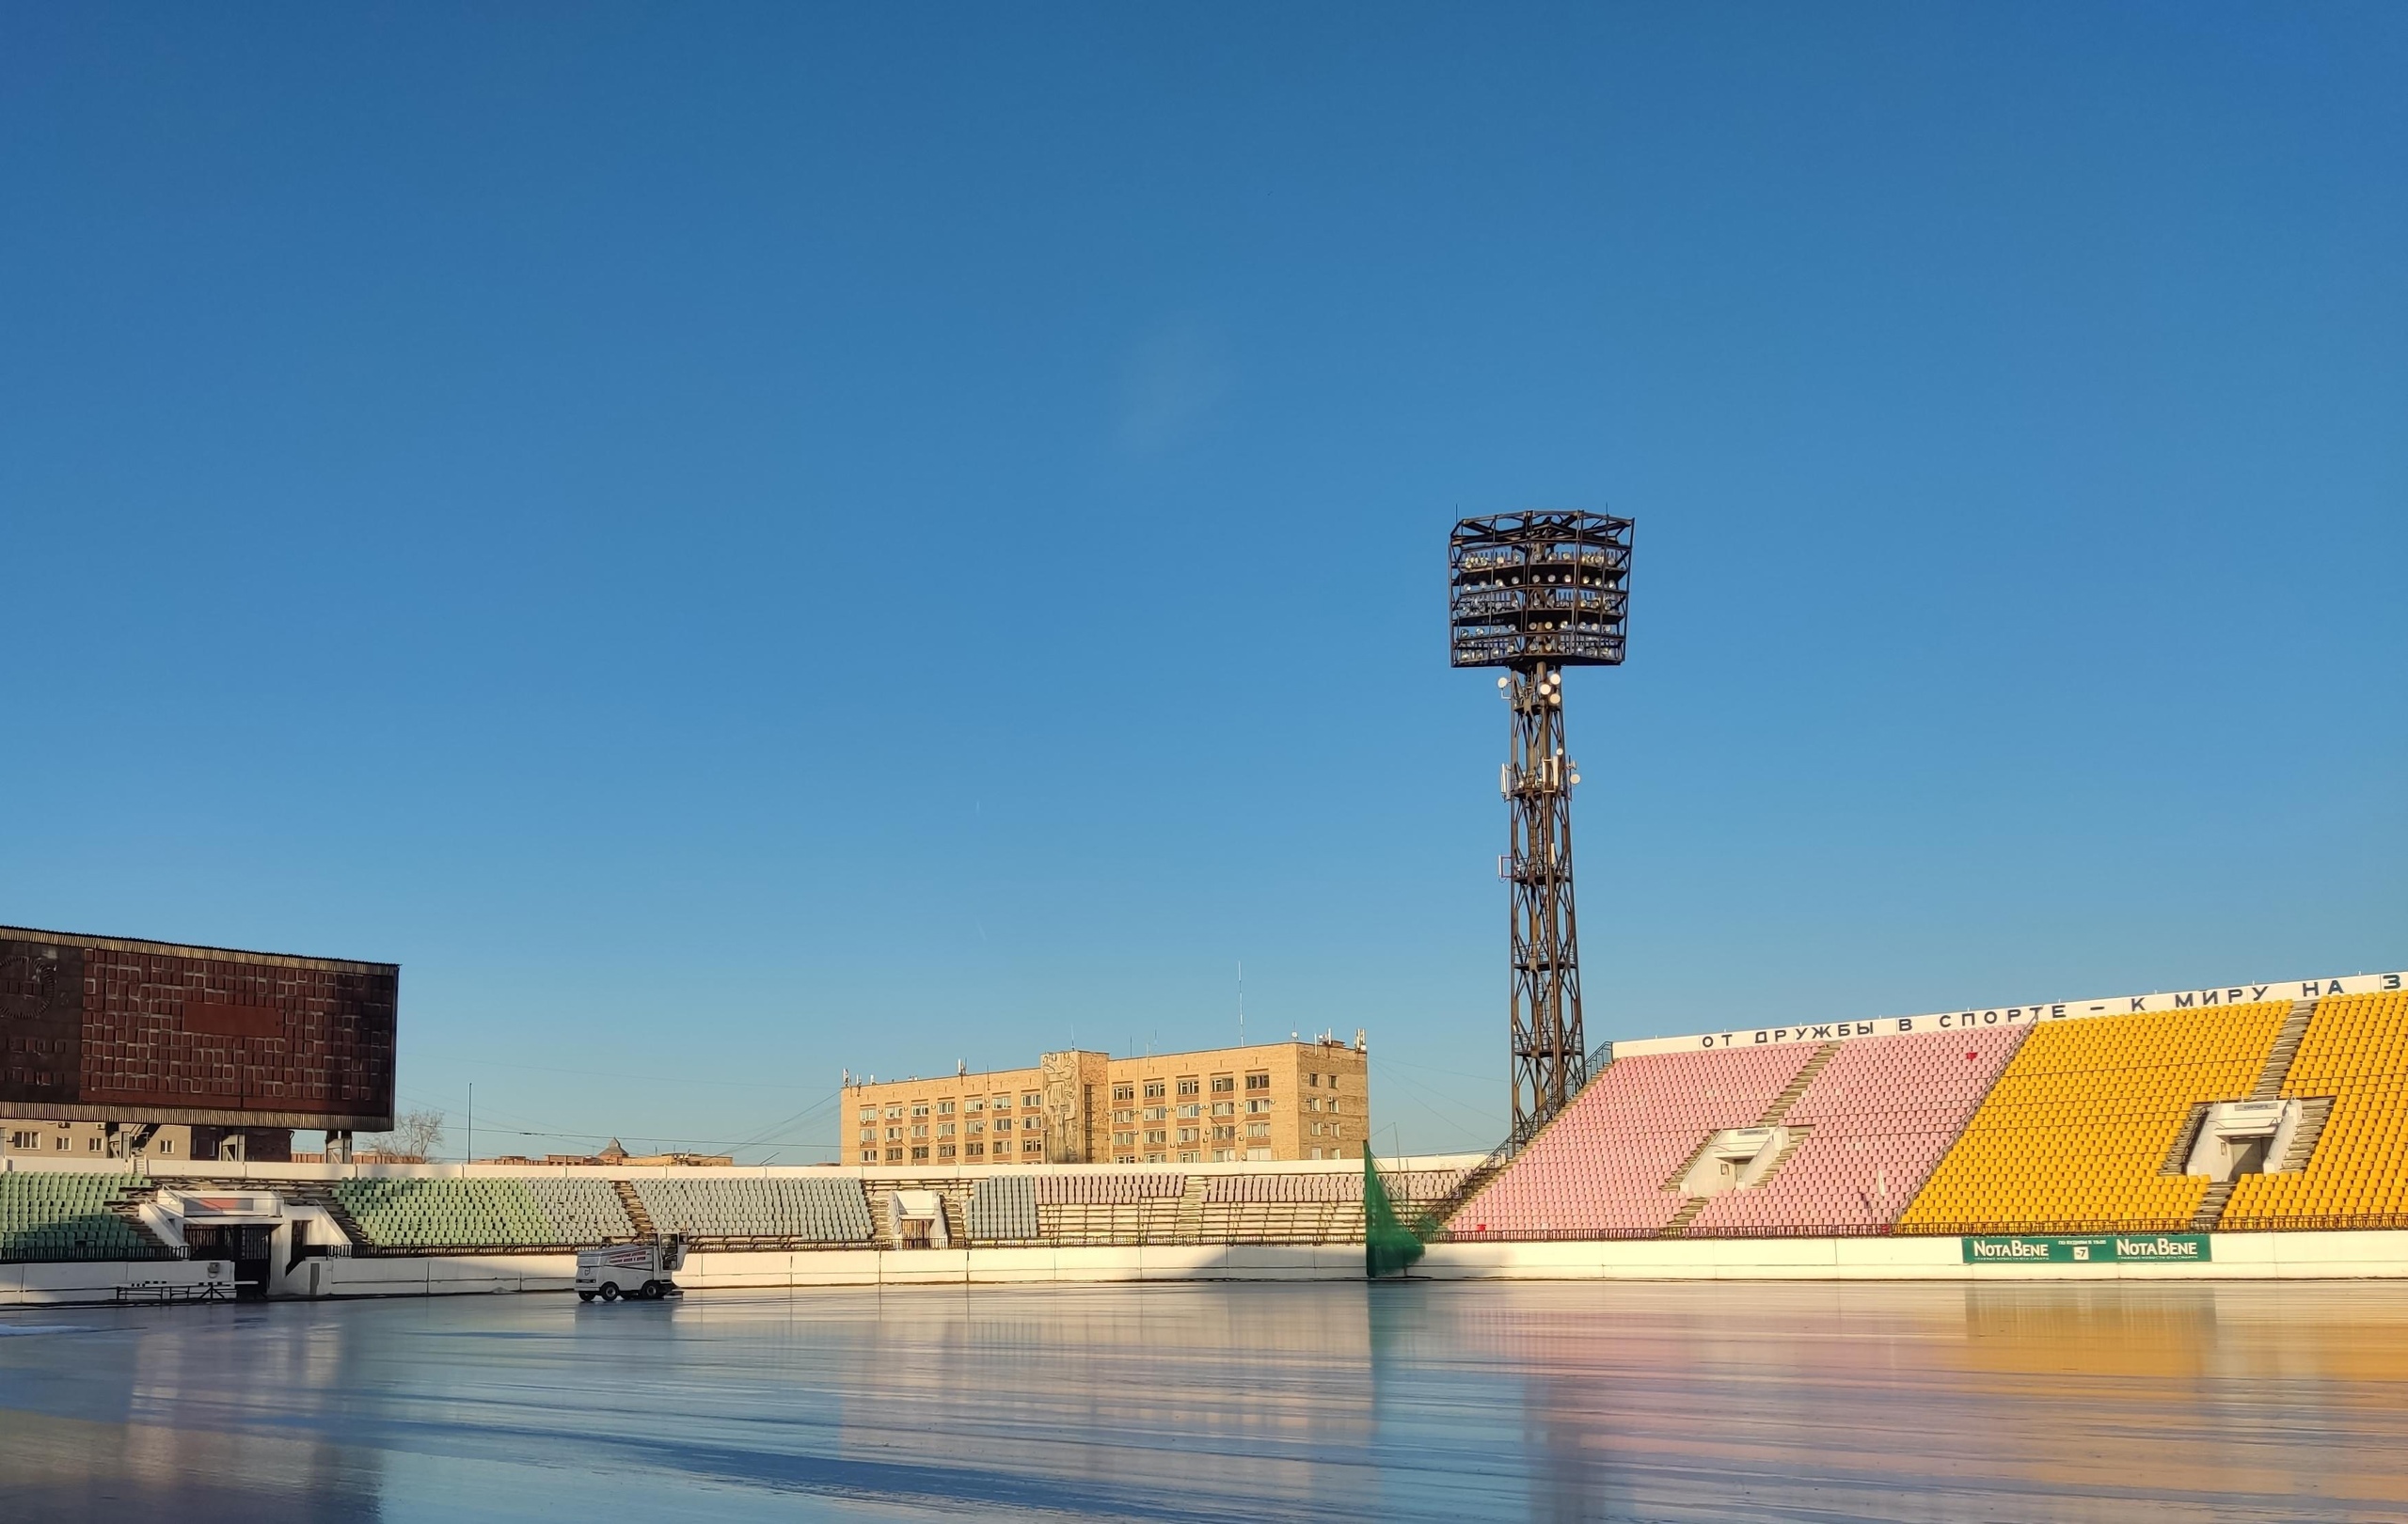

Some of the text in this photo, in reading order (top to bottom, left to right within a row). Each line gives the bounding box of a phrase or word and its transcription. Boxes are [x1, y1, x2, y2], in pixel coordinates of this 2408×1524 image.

[1702, 1035, 1733, 1048] ОТ
[1755, 1022, 1874, 1044] ДРУЖБЫ
[1898, 1018, 1913, 1032] В
[1939, 1005, 2067, 1028] СПОРТЕ
[2131, 997, 2147, 1012] К
[2175, 985, 2269, 1008] МИРУ
[2302, 979, 2345, 997] НА
